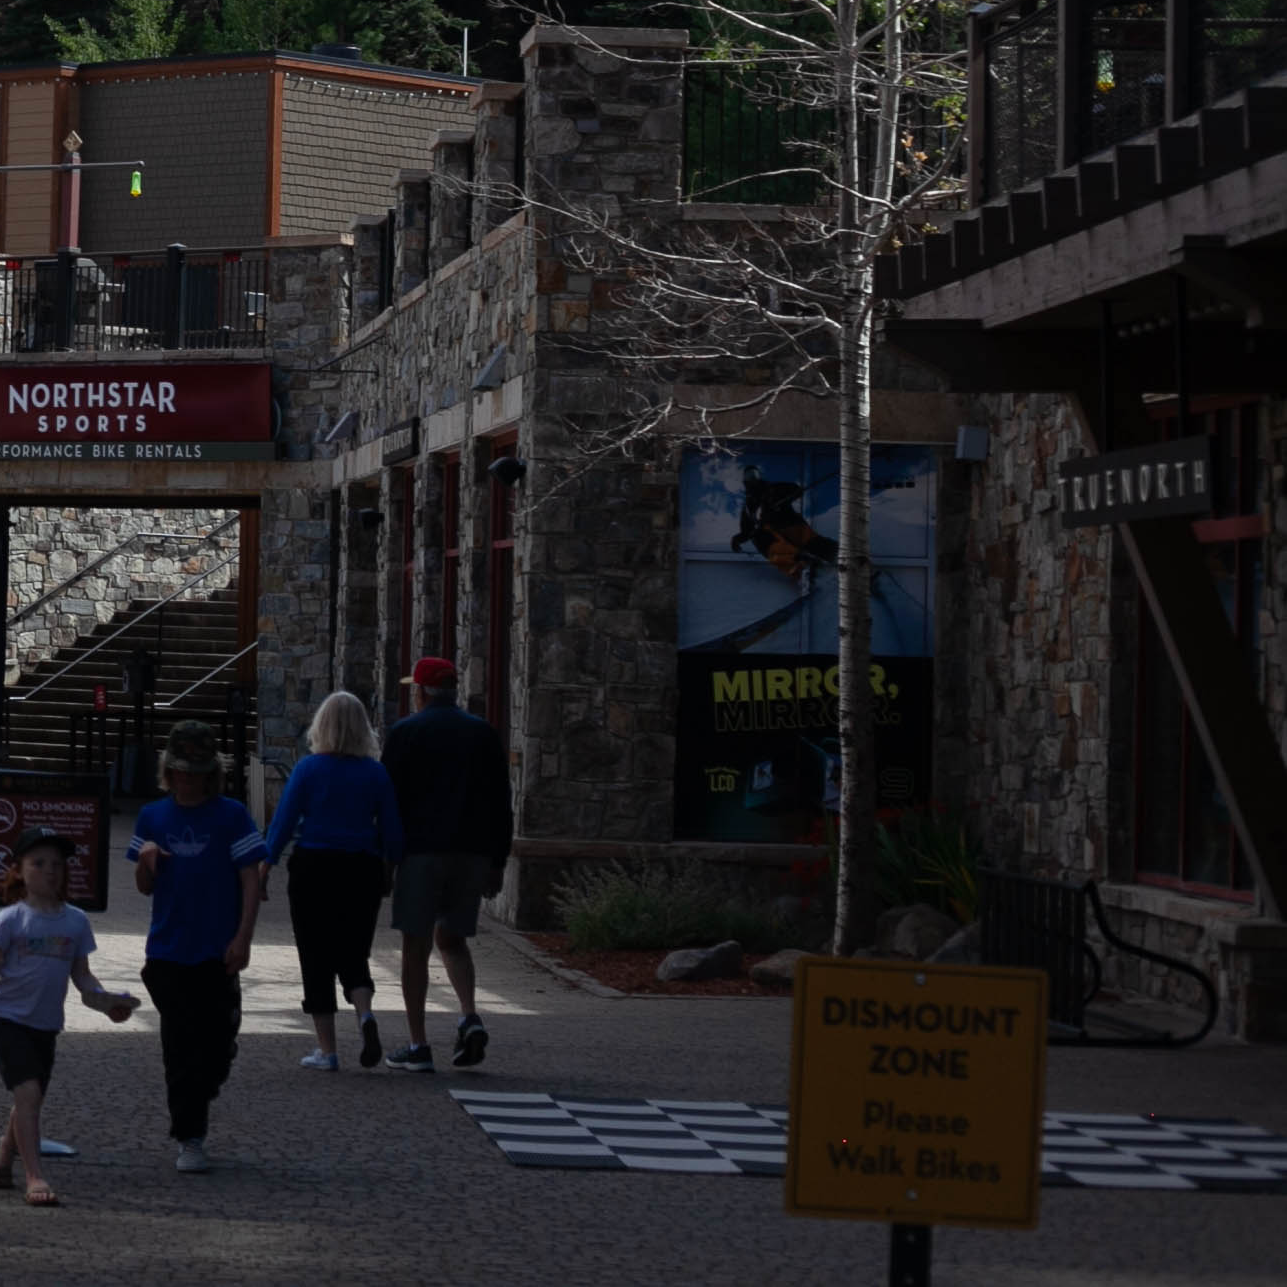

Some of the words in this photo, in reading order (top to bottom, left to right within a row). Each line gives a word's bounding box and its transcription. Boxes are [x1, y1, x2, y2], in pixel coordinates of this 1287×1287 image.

[7, 380, 177, 414] NORTHSTAR
[37, 414, 147, 433] SPORTS
[92, 444, 126, 459] BIKE
[135, 444, 203, 459] RENTALS
[21, 800, 40, 811] NO
[41, 801, 96, 814] SMOKING
[822, 996, 1022, 1038] DISMOUNT
[869, 1044, 970, 1081] ZONE
[863, 1100, 970, 1137] Please
[827, 1140, 905, 1177] Walk
[915, 1147, 1002, 1184] Bikes
